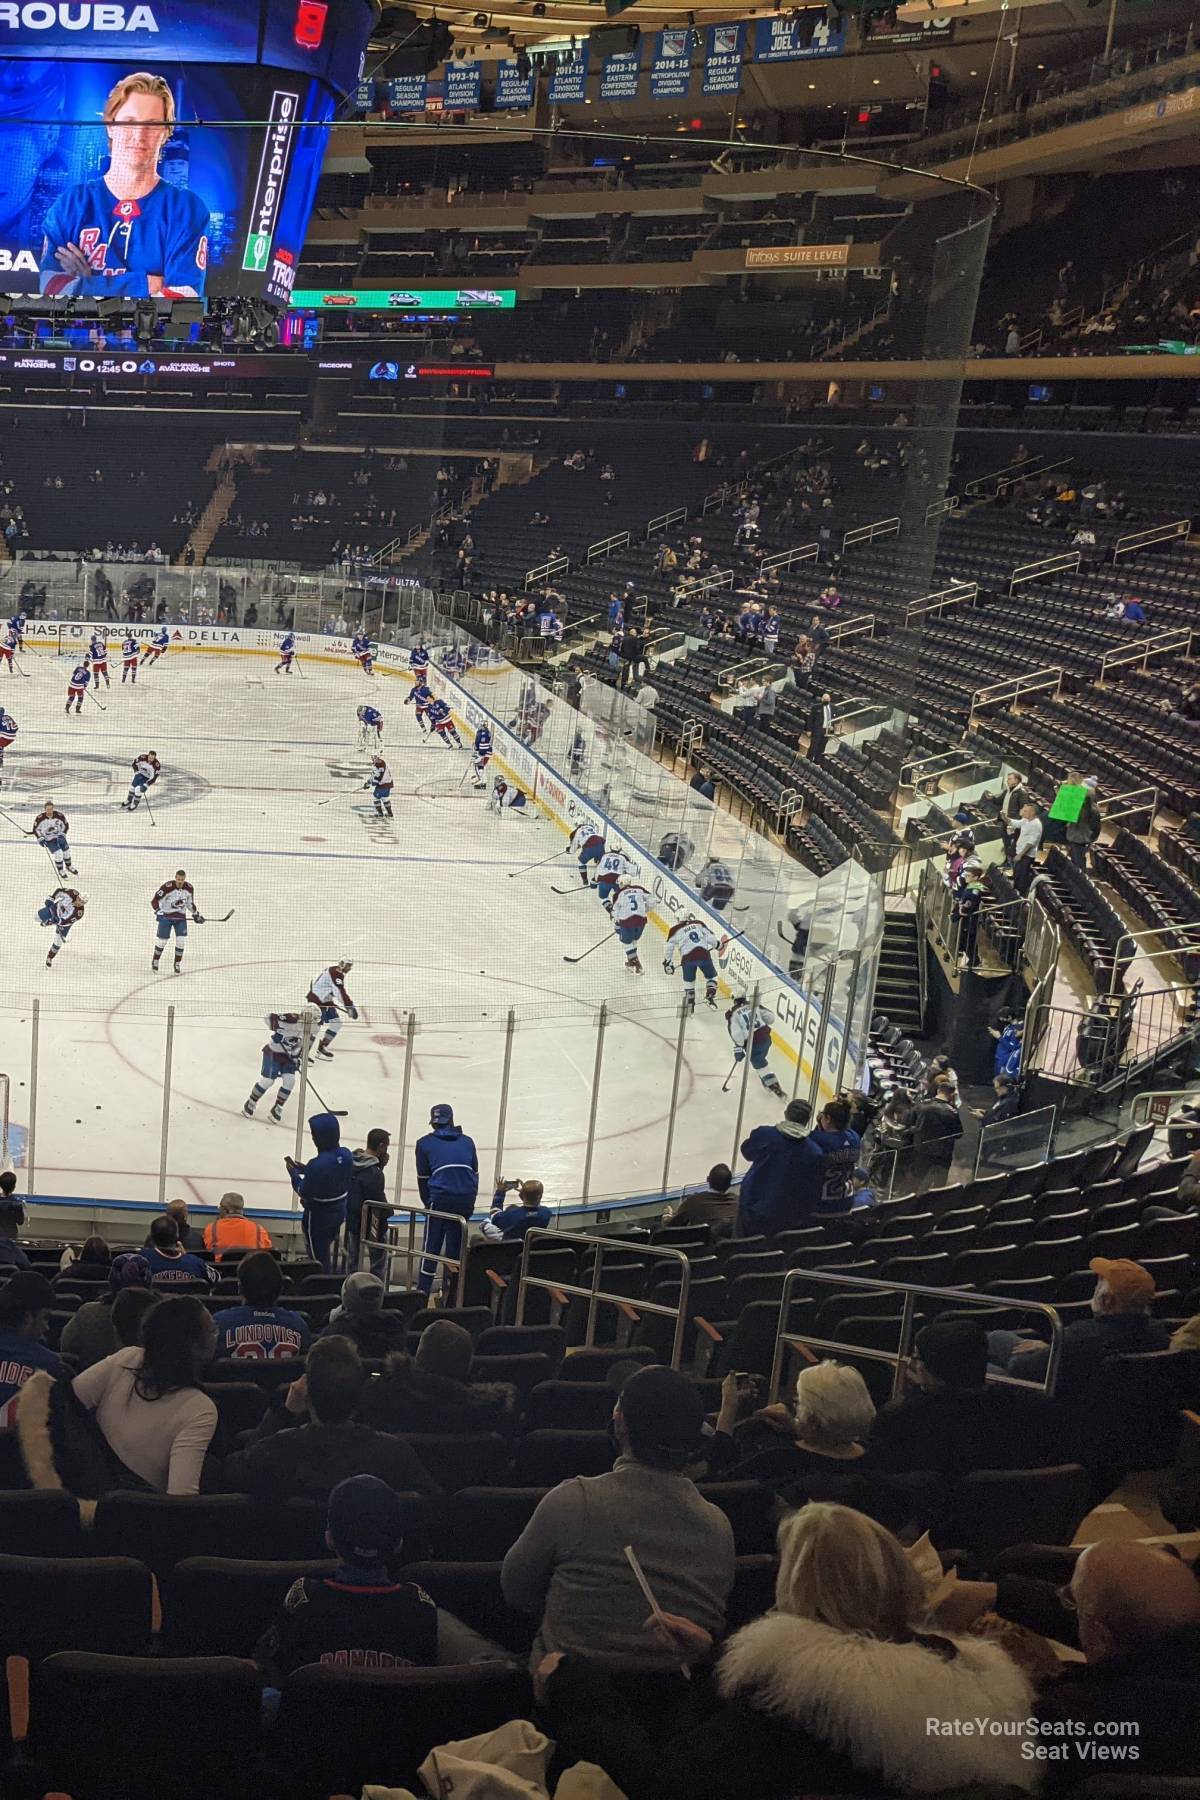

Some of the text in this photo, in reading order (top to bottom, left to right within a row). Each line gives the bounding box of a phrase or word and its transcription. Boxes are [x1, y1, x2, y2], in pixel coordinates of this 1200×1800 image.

[295, 0, 328, 49] 8
[771, 20, 797, 36] BILLY
[771, 36, 793, 51] JOEL
[655, 59, 689, 70] 2014-15
[707, 54, 741, 67] 2014-15
[606, 63, 638, 74] 2013-14
[708, 67, 737, 76] REGULAR
[447, 71, 480, 81] 1993-94
[606, 74, 634, 83] EASTERN
[651, 71, 690, 80] METROPOLITAN
[709, 75, 734, 83] SEASON
[500, 80, 529, 88] REGULAR
[553, 76, 582, 85] ATLANTIC
[657, 79, 681, 87] DIVISION
[448, 83, 476, 91] ATLANTIC
[554, 84, 580, 93] DIVISION
[601, 82, 638, 90] CONFERENCE
[703, 82, 739, 92] CHAMPIONS
[502, 87, 527, 95] SEASON
[549, 91, 584, 100] CHAMPIONS
[601, 89, 635, 97] CHAMPIONS
[652, 87, 685, 95] CHAMPIONS
[444, 98, 478, 106] CHAMPIONS
[496, 94, 531, 102] CHAMPIONS
[253, 97, 292, 269] enterprise
[784, 252, 812, 262] SUITE
[814, 250, 843, 261] LEVEL
[96, 365, 121, 374] 12:45
[395, 578, 421, 588] ULTRA
[94, 626, 154, 639] Spectrum
[188, 630, 240, 642] DELTA
[628, 895, 638, 911] 3
[730, 947, 753, 976] pepsi
[777, 992, 817, 1049] CHAS
[1153, 1103, 1167, 1114] 113
